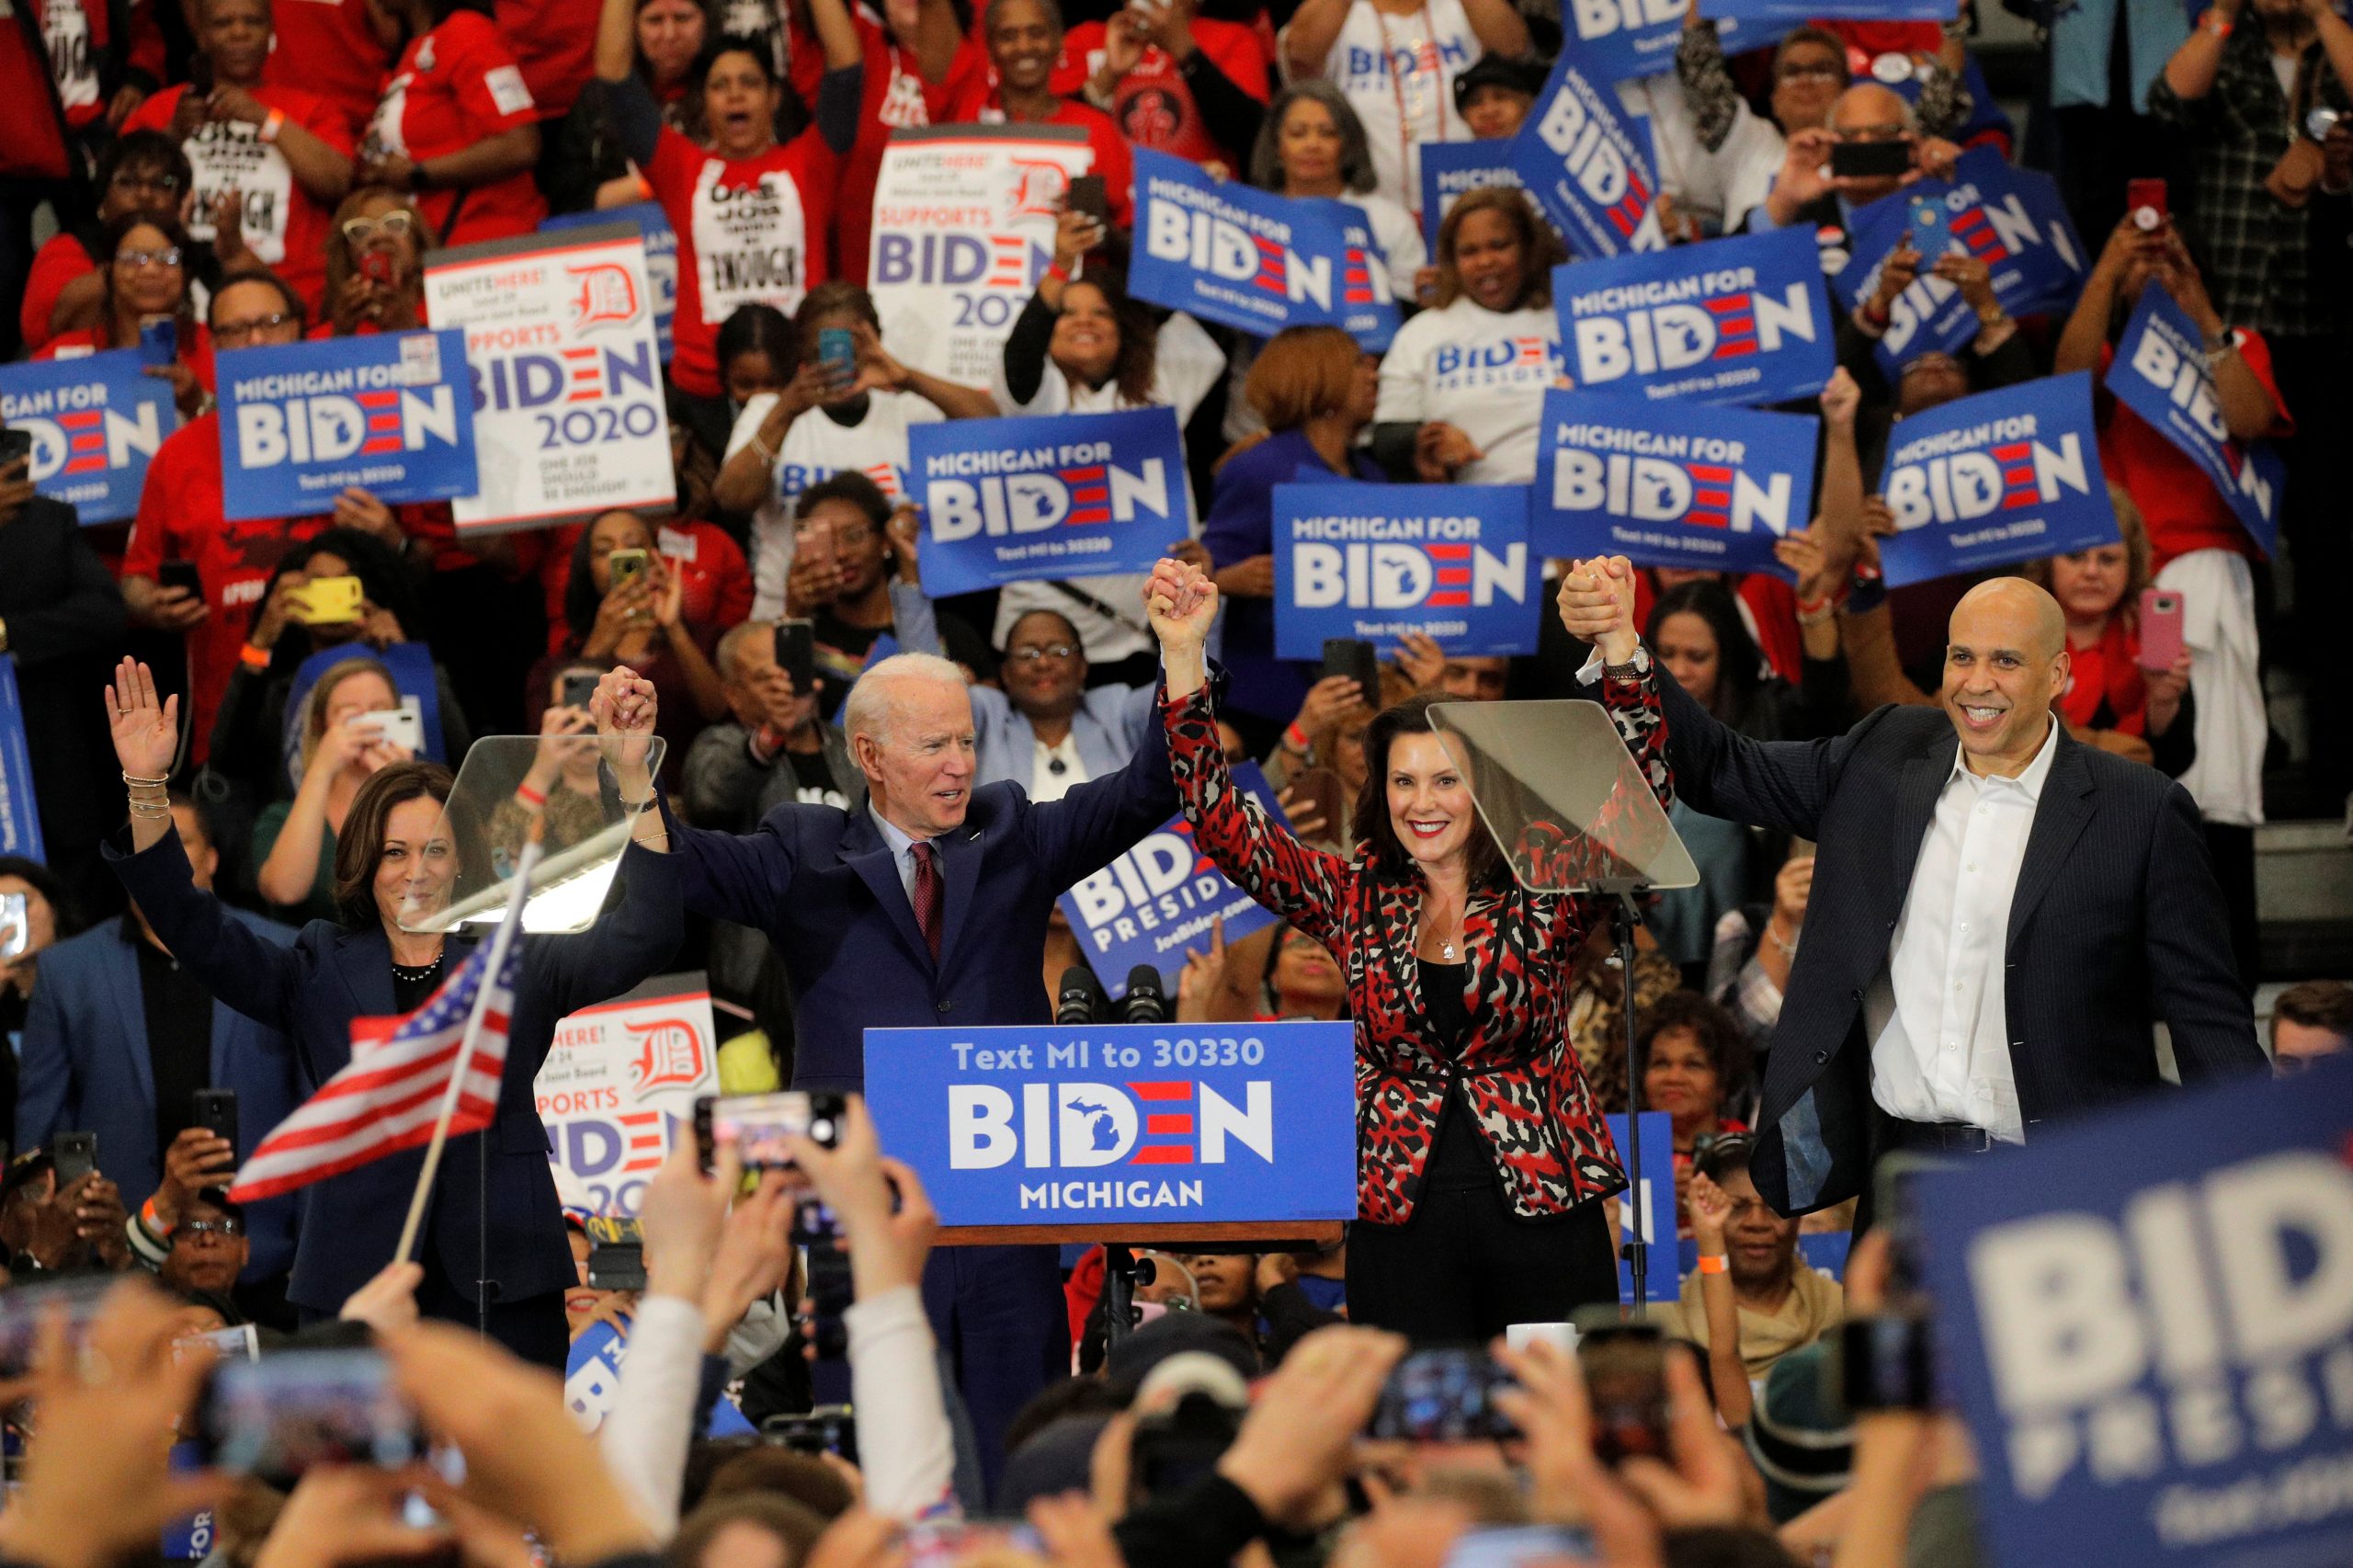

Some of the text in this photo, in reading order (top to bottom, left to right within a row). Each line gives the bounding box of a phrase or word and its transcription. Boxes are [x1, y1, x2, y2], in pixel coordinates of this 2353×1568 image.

[1946, 183, 1980, 212] OR
[1147, 197, 1332, 312] BIDEN
[953, 292, 1030, 328] 20
[1571, 267, 1756, 316] MICHIGAN FOR
[469, 323, 563, 353] PPORTS
[1574, 281, 1816, 385] BIDEN
[56, 382, 108, 411] FOR
[234, 368, 355, 402] MICHIGAN
[236, 384, 458, 470] BIDEN
[536, 403, 658, 450] 2020
[1556, 422, 1745, 464] MICHIGAN FOR
[1893, 414, 2038, 467] MICHIGAN FOR
[2131, 326, 2272, 522] BIDN
[926, 442, 1112, 477] MICHIGAN FOR
[1887, 432, 2090, 531] BIDEN
[927, 458, 1169, 543] BIDEN
[1552, 447, 1791, 538] BIDEN
[1292, 517, 1481, 540] MICHIGAN FOR
[1292, 541, 1528, 608] BIDEN
[1068, 819, 1216, 930] BID
[1092, 871, 1237, 953] PRESID
[545, 1068, 572, 1084] Joint
[574, 1064, 608, 1081] Board
[951, 1037, 1265, 1070] Text MI to 30330
[544, 1110, 677, 1177] IDE
[948, 1080, 1274, 1170] BIDEN
[1020, 1179, 1203, 1210] MICHIGAN
